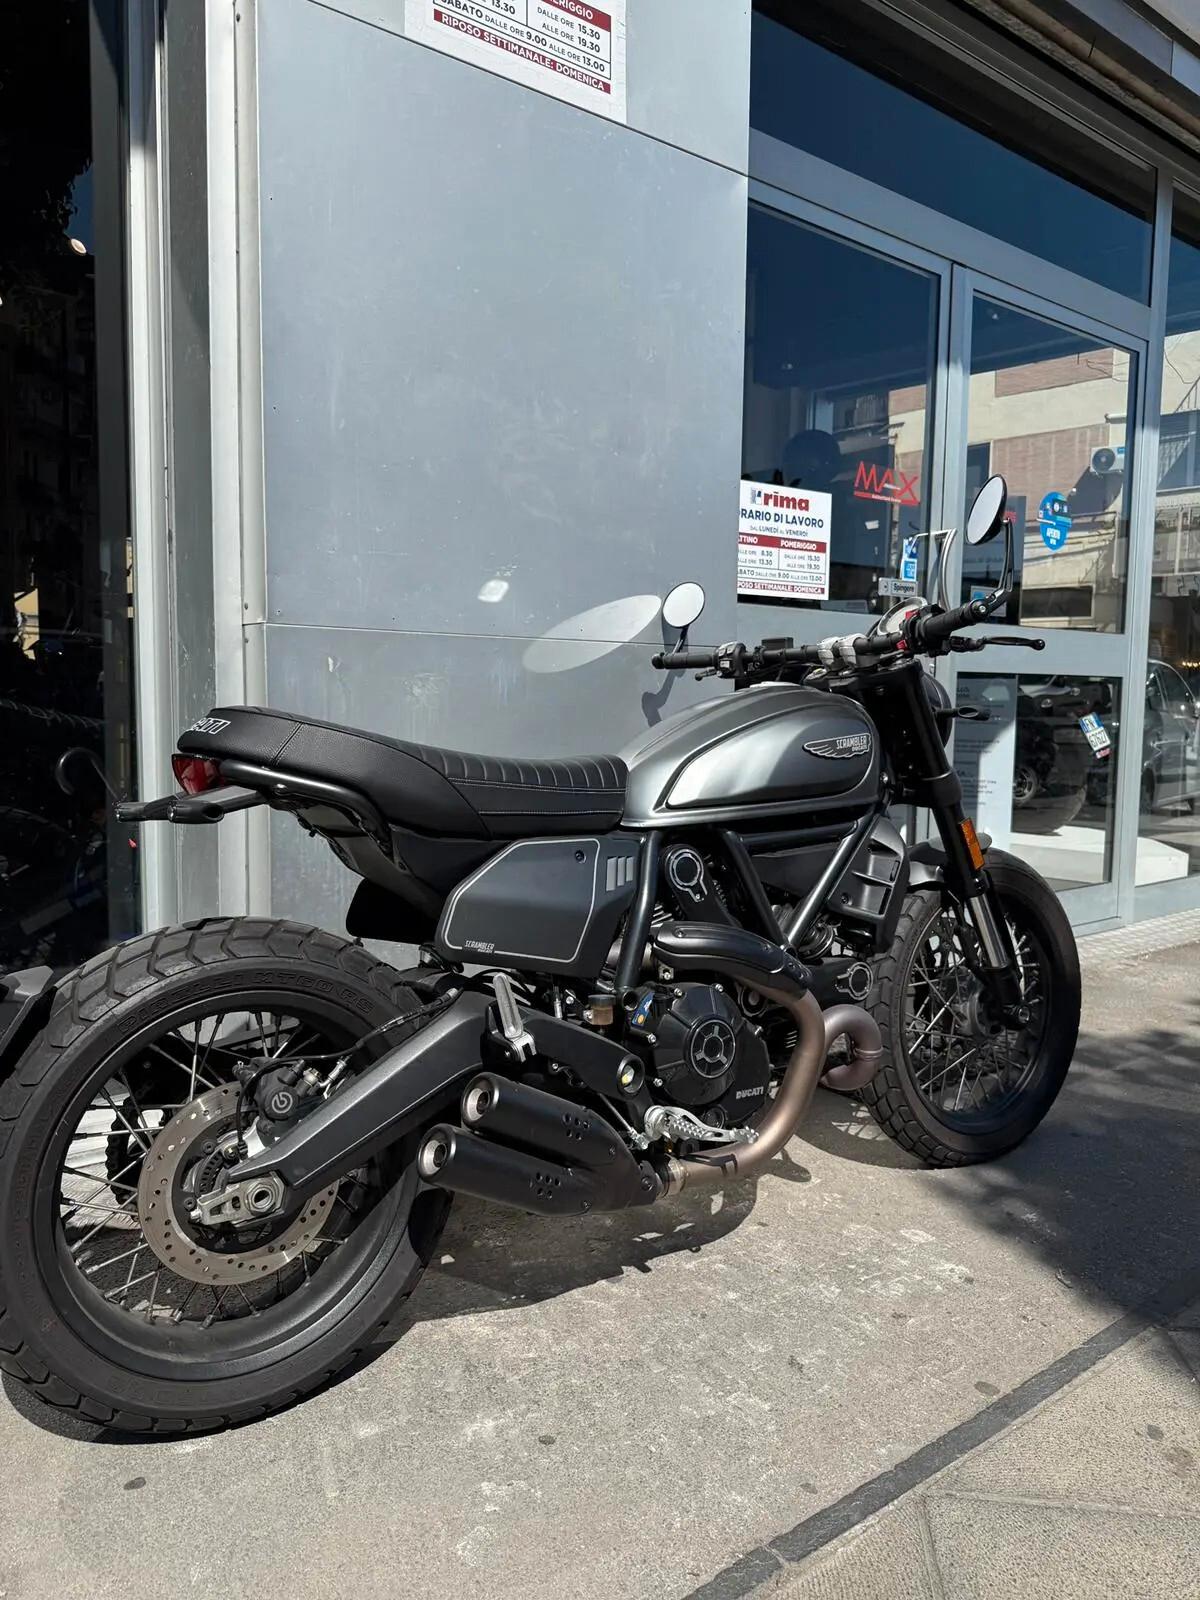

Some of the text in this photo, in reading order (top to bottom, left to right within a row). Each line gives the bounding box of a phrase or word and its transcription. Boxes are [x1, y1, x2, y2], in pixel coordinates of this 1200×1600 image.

[549, 0, 593, 20] ERIGGIO
[537, 7, 601, 40] DALLE ORE 15.30
[485, 14, 508, 30] DALLE
[509, 25, 525, 38] ORE
[526, 31, 547, 47] 9.00
[549, 43, 566, 56] ALLE
[567, 51, 581, 63] ORE
[582, 55, 605, 72] 13.00
[542, 23, 601, 53] ALLE ORE 19.30
[441, 14, 605, 91] RIPOSO SETTIMANALE: DOMENICA
[854, 460, 919, 501] MAX
[741, 508, 824, 529] RARIO DI LAVORO
[739, 535, 758, 544] TTINO
[780, 540, 817, 551] POMERIGGIO
[739, 568, 755, 576] BATO
[836, 736, 867, 749] SCRAMBLER
[465, 940, 495, 950] SCRAMBLER
[736, 1087, 764, 1100] DUCATI
